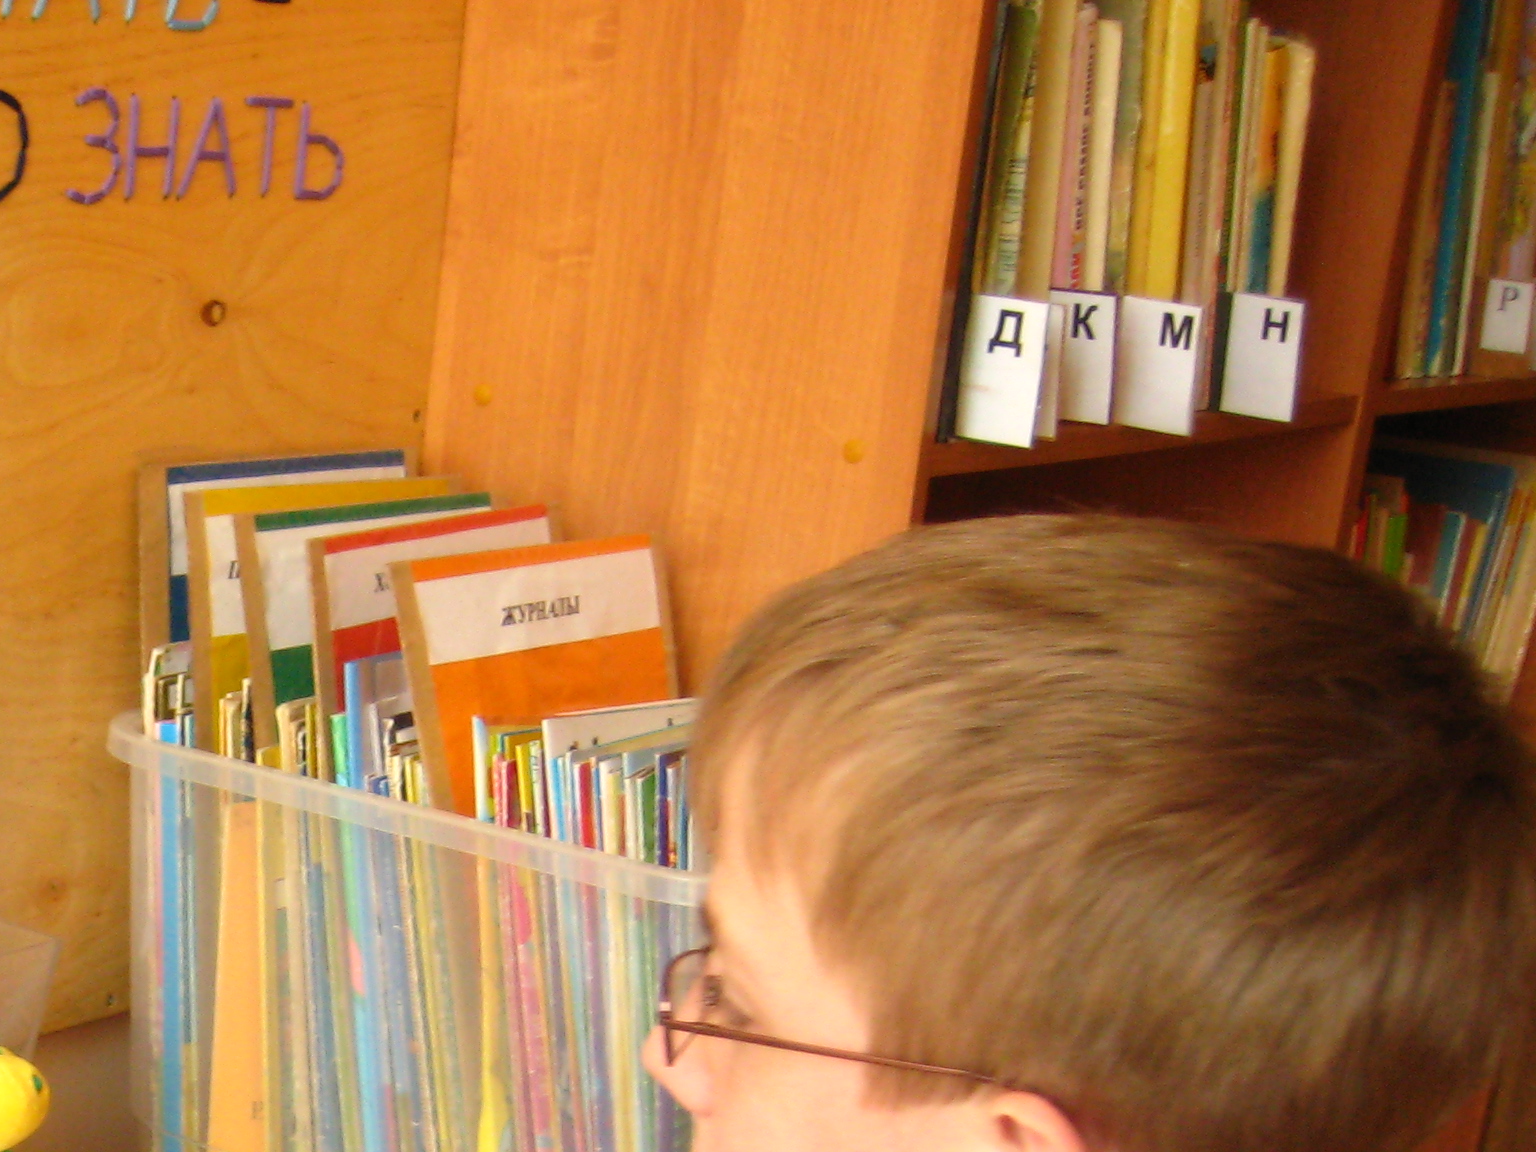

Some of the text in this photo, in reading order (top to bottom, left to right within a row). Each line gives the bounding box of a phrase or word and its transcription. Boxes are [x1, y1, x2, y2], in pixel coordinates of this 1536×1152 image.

[65, 86, 345, 206] ЗНАТЬ
[987, 309, 1024, 358] Д
[1070, 303, 1098, 341] К
[1160, 313, 1195, 350] М
[1263, 307, 1291, 343] Н
[501, 594, 580, 627] ЖУРНАЛЫ
